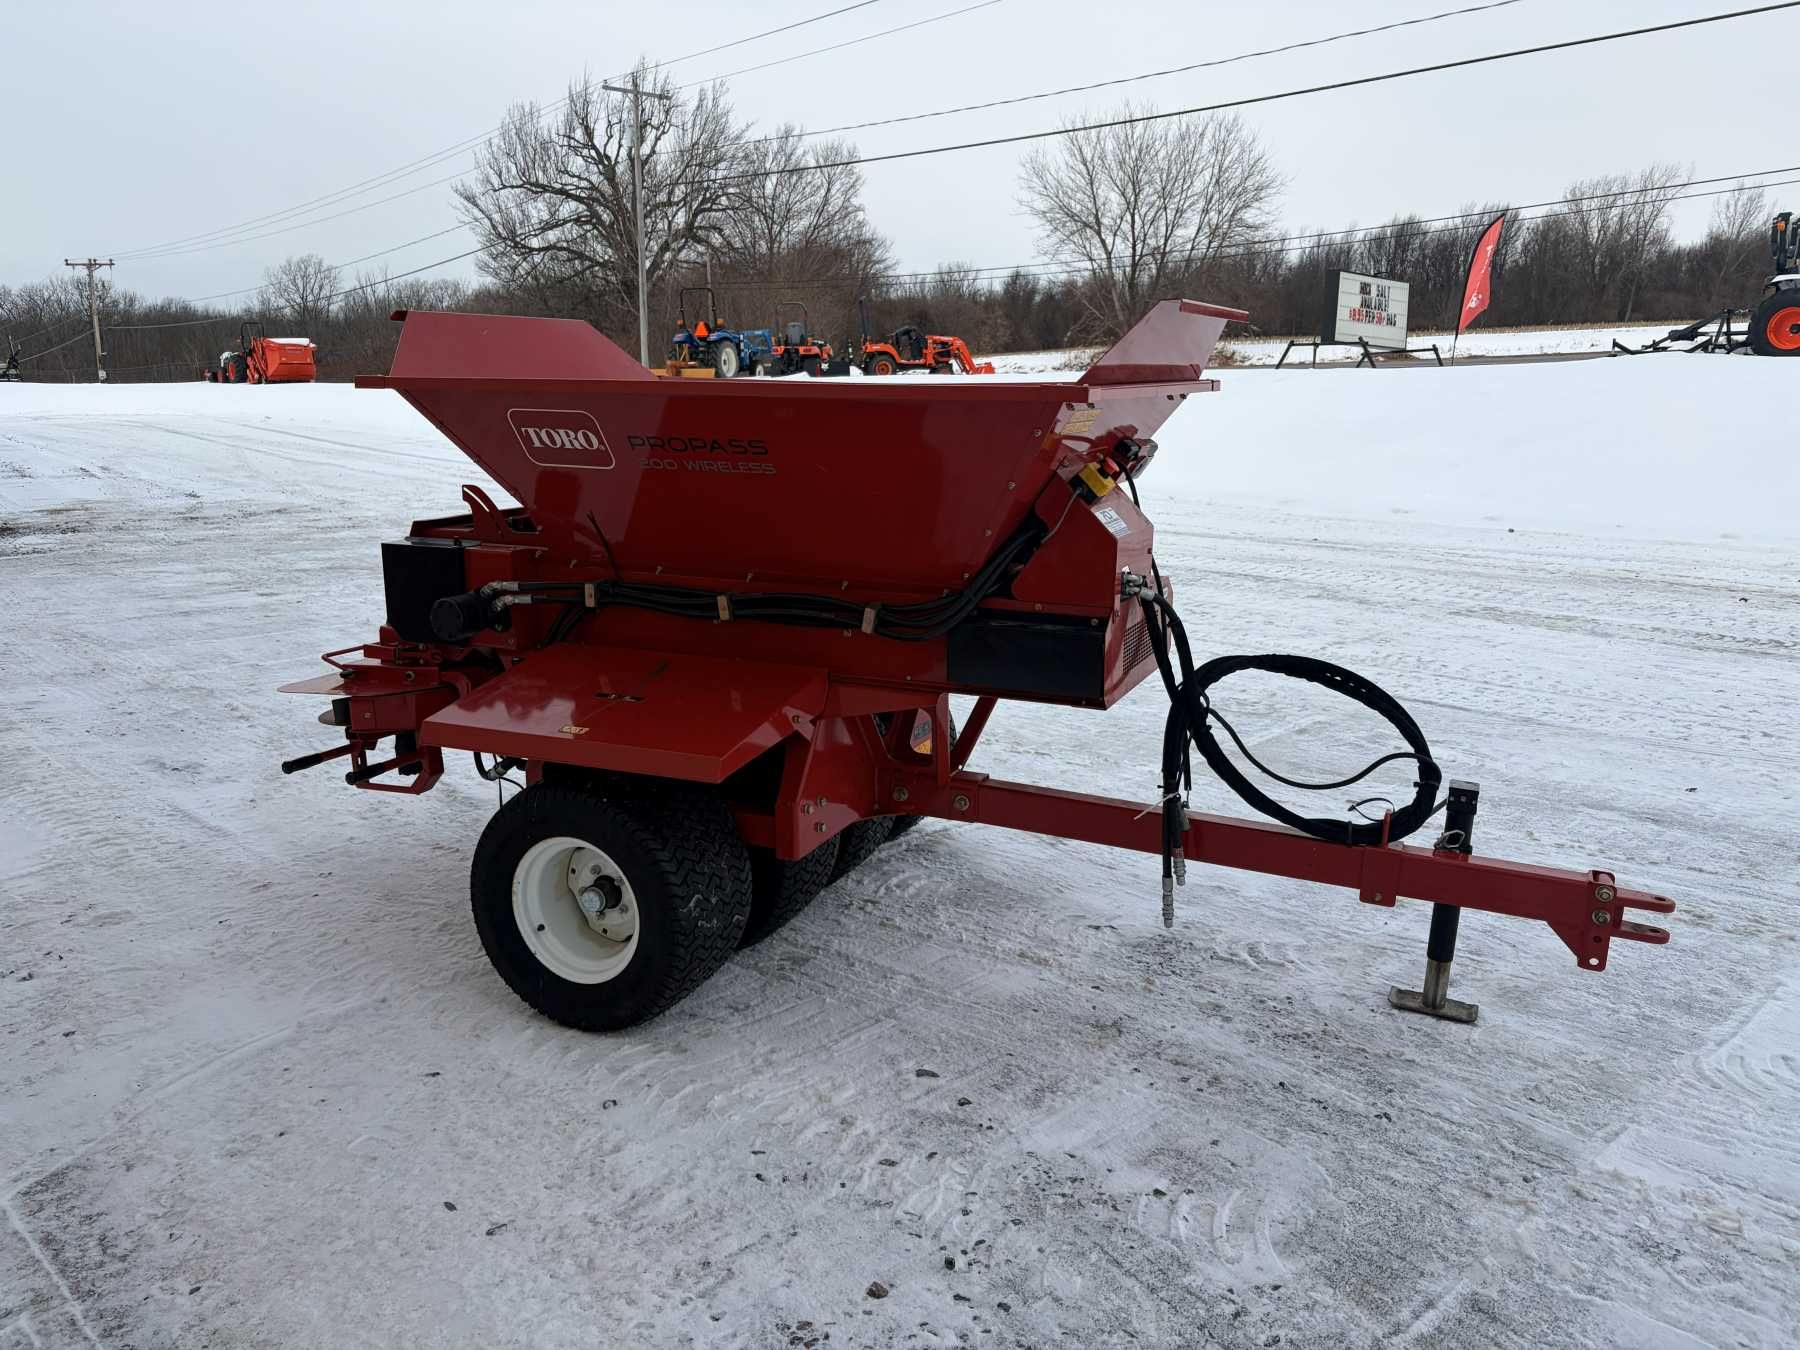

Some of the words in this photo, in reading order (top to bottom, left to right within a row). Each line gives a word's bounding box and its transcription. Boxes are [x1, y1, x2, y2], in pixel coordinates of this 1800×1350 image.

[626, 435, 769, 456] PROPASS
[639, 457, 678, 470] 200
[685, 460, 777, 475] WIRELESS
